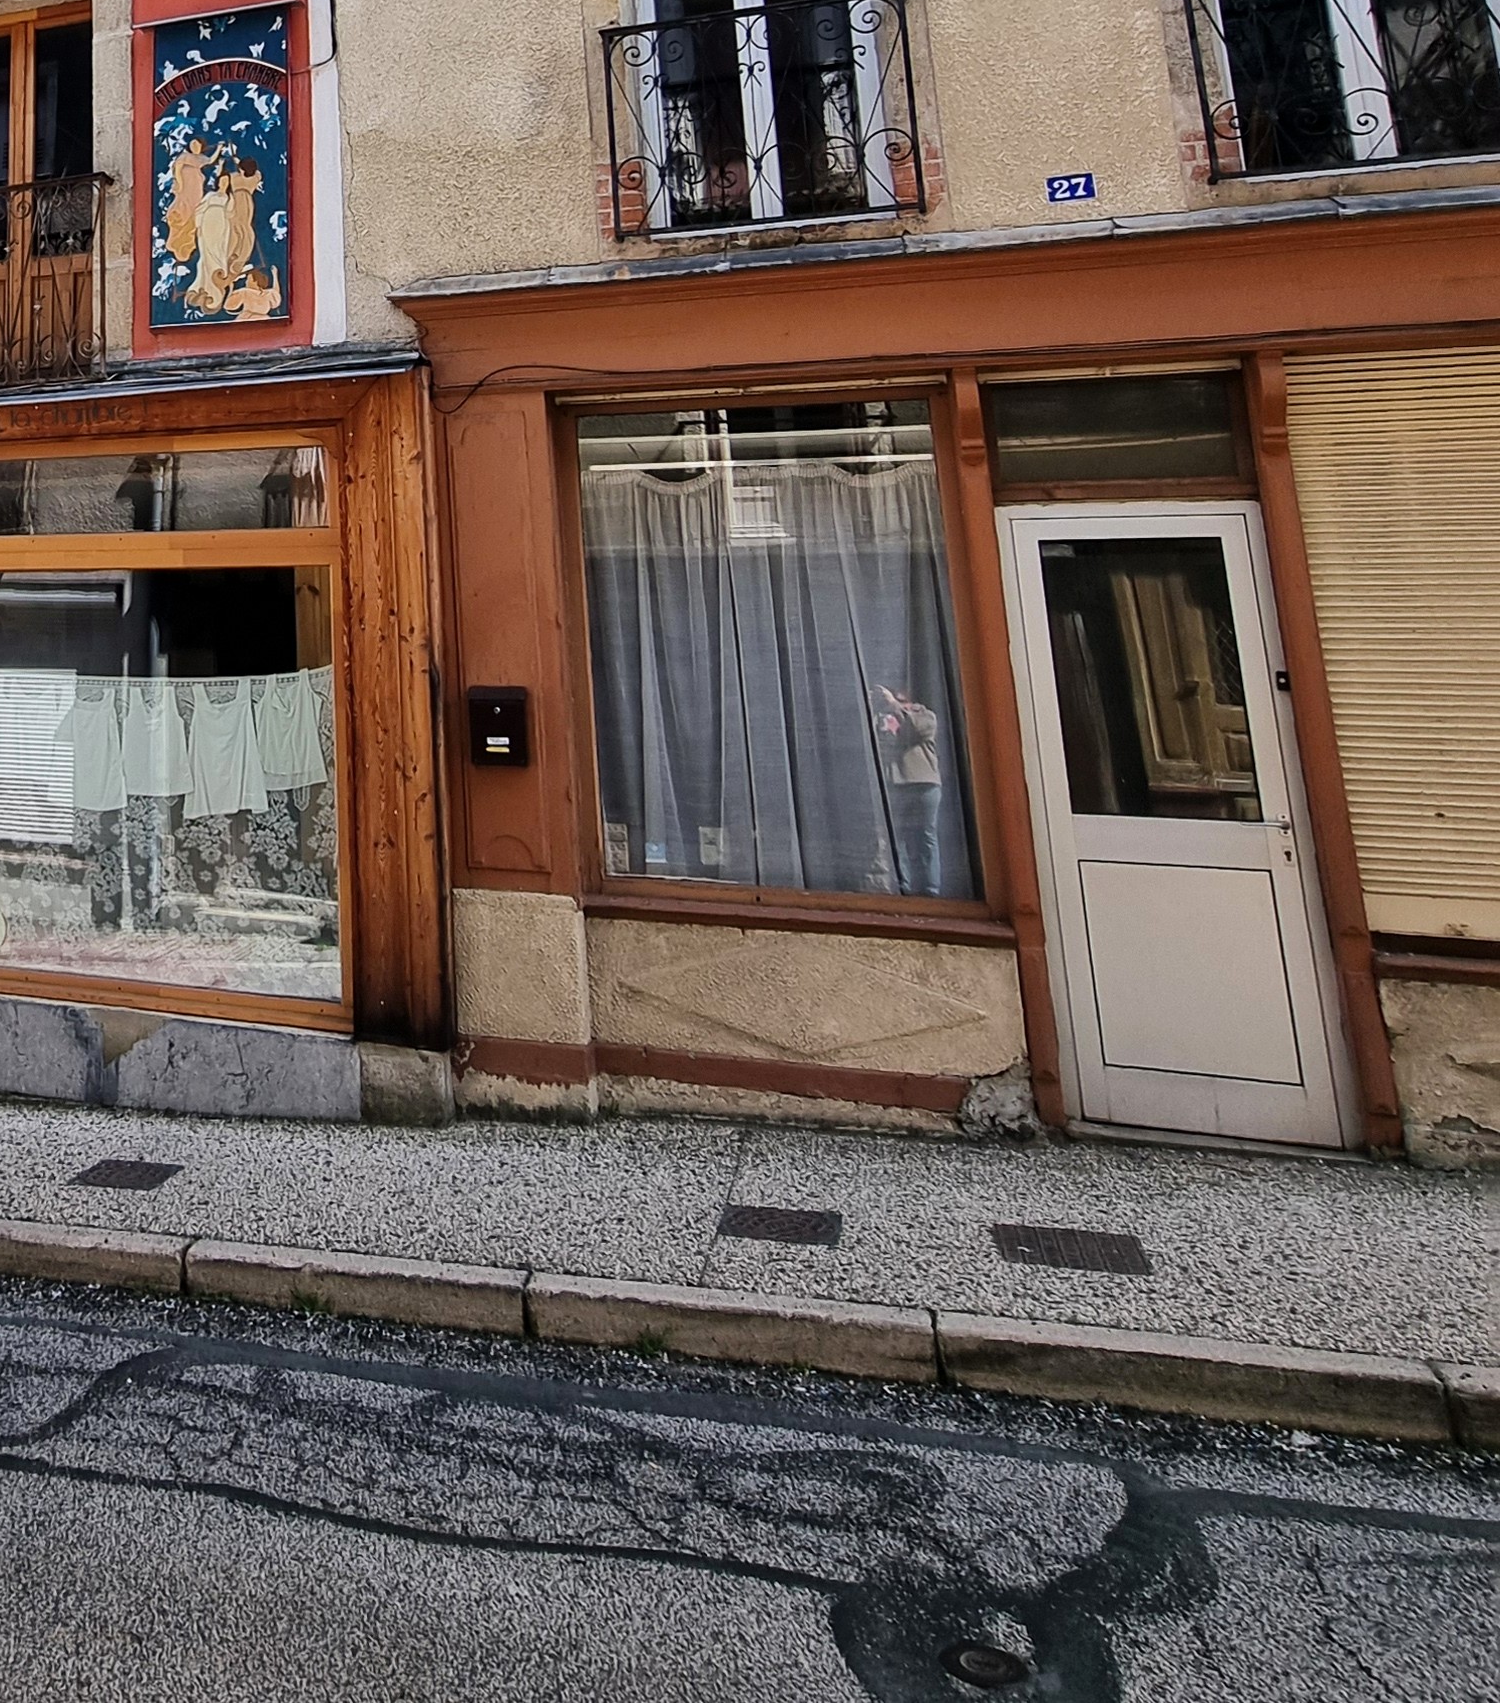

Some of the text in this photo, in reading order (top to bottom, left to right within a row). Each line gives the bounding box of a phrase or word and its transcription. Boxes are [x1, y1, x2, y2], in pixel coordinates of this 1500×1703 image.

[183, 66, 212, 91] DANS
[217, 62, 232, 79] TA
[236, 61, 284, 90] CHAMBRE
[1052, 177, 1088, 199] 27
